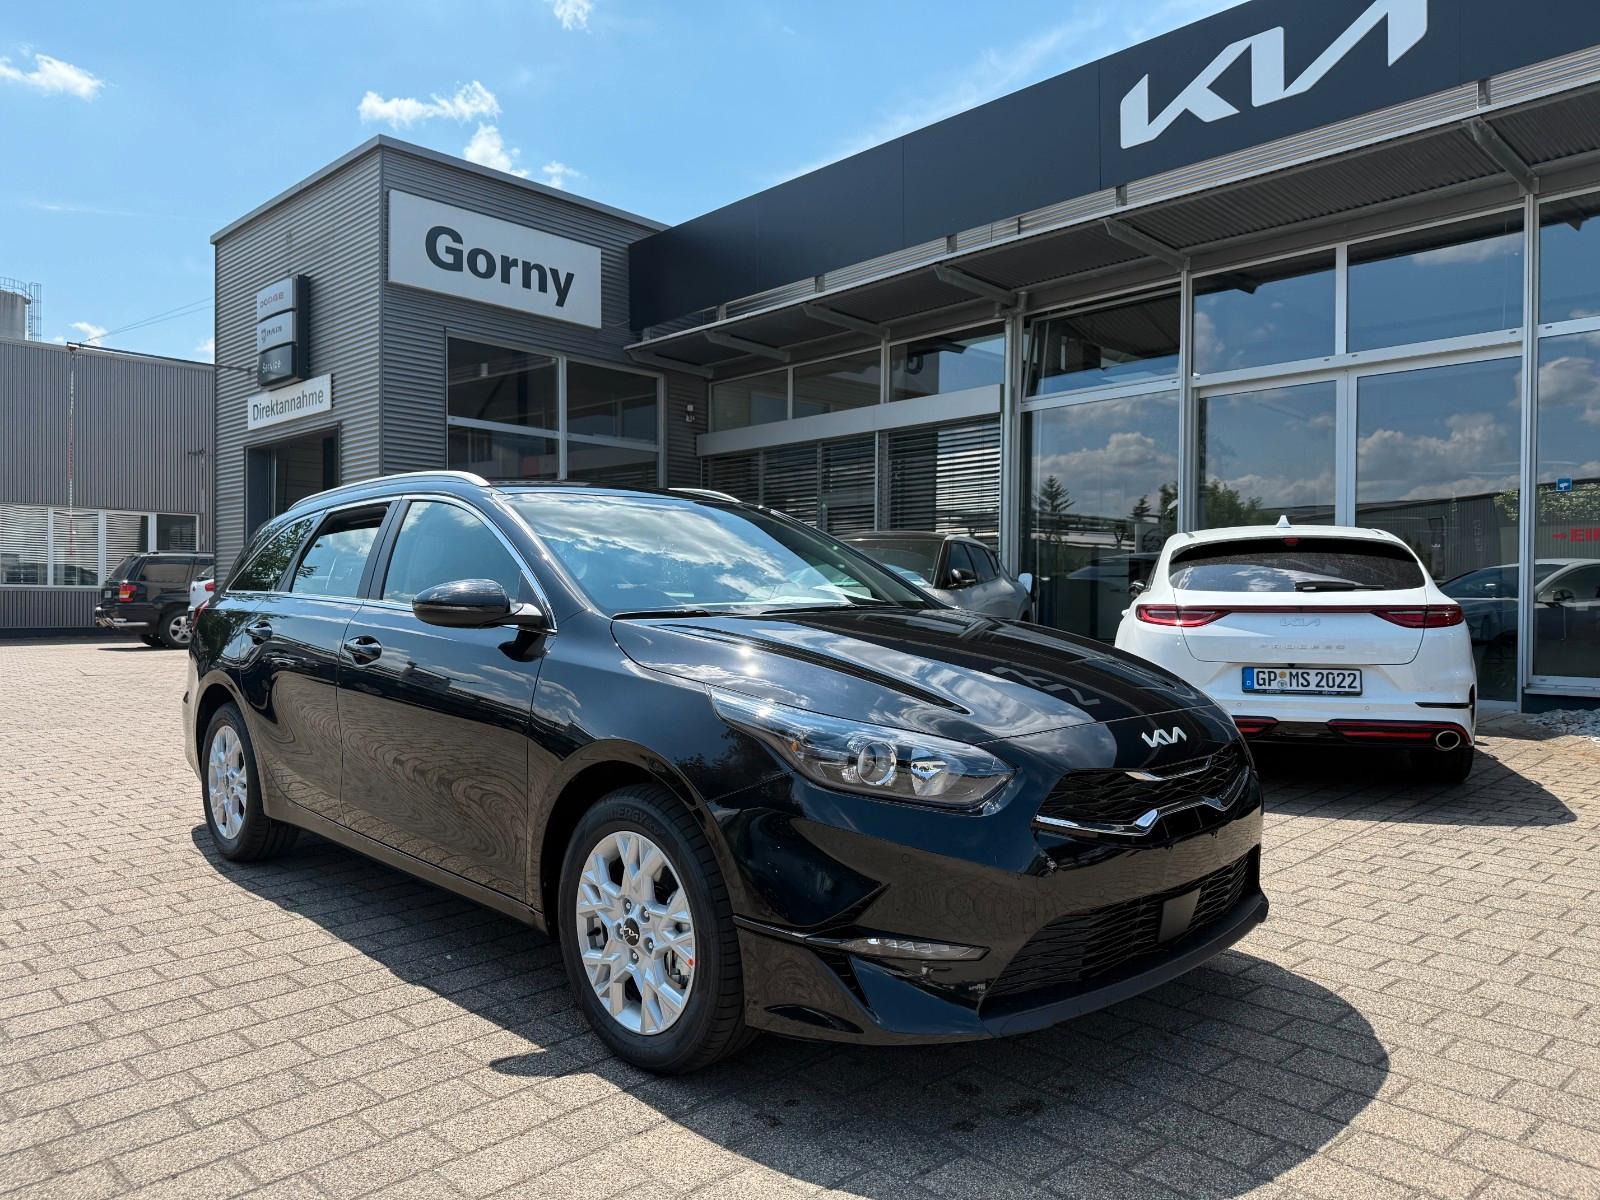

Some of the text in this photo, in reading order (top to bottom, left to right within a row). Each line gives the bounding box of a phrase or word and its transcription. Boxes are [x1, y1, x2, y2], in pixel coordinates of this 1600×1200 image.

[1120, 0, 1427, 149] KIA
[425, 225, 575, 308] Gorny
[259, 290, 285, 309] DODGE
[252, 387, 324, 421] Direktannahme
[1256, 670, 1277, 687] GP
[1289, 671, 1311, 688] MS
[1315, 672, 1358, 689] 2022
[1141, 726, 1187, 748] KIA
